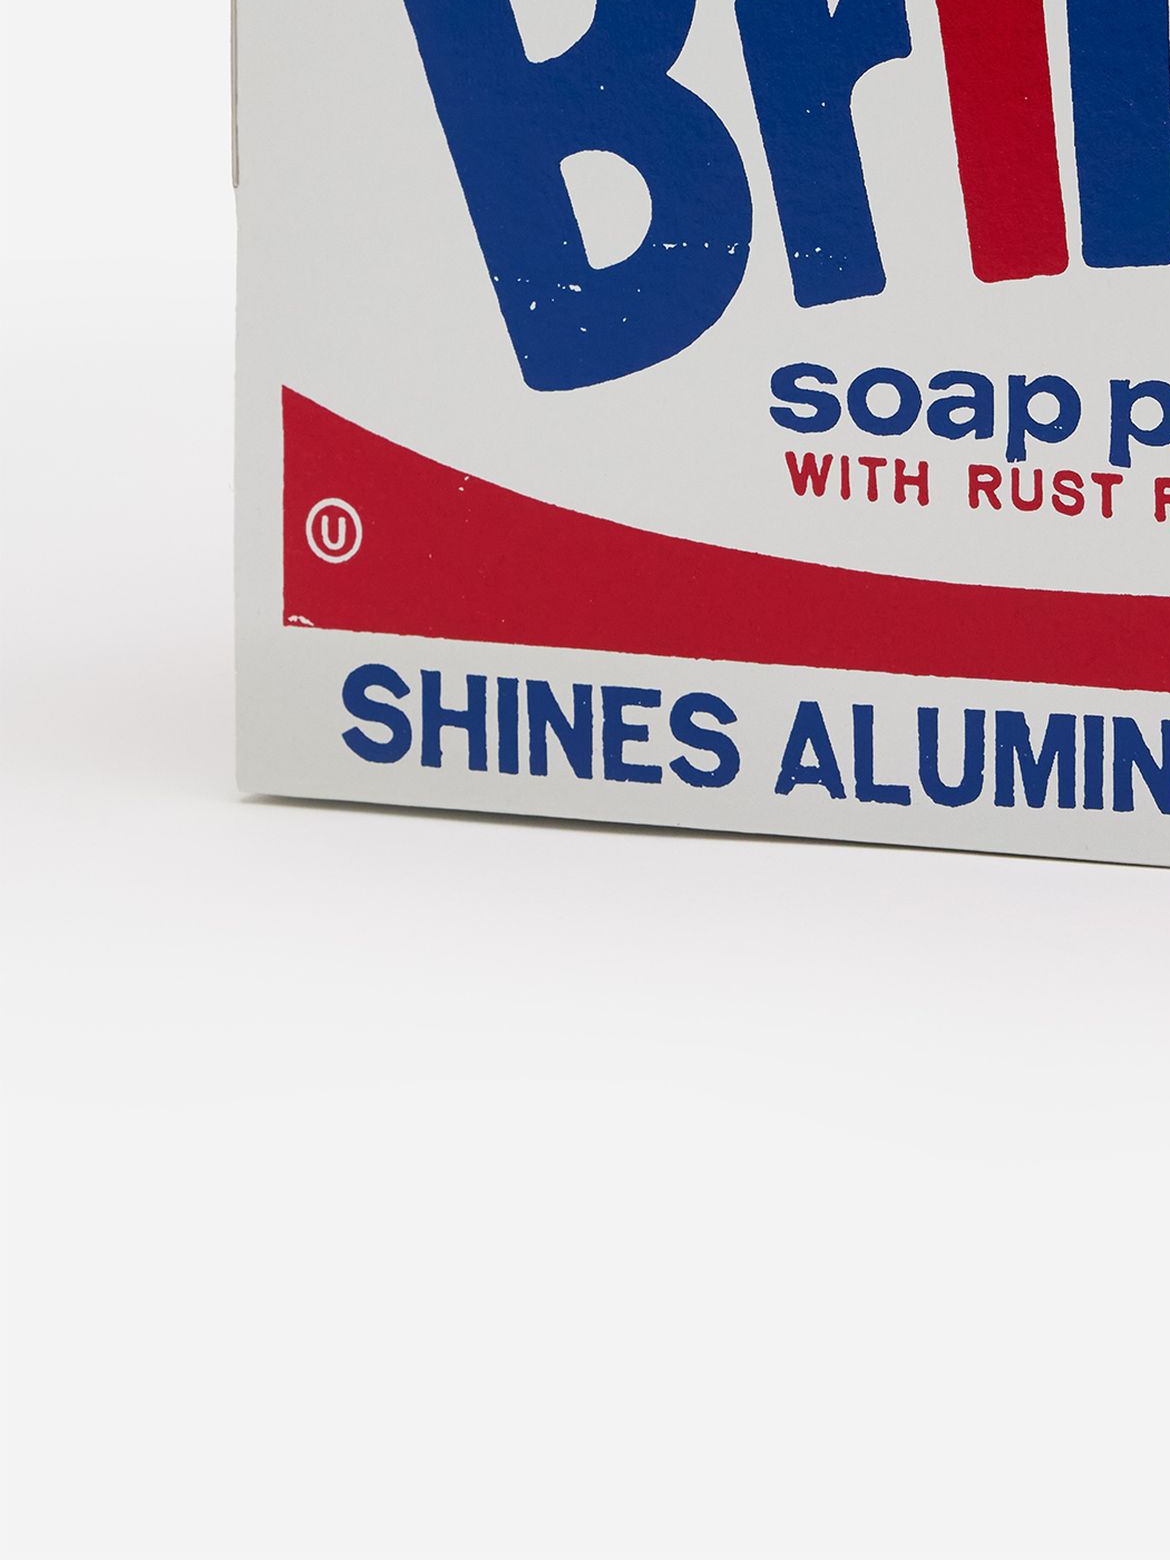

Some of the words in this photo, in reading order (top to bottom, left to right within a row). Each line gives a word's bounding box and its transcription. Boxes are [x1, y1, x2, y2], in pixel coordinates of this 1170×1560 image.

[769, 361, 1082, 463] soap
[784, 450, 930, 507] WITH
[967, 464, 1124, 519] RUST
[341, 662, 741, 789] SHINES
